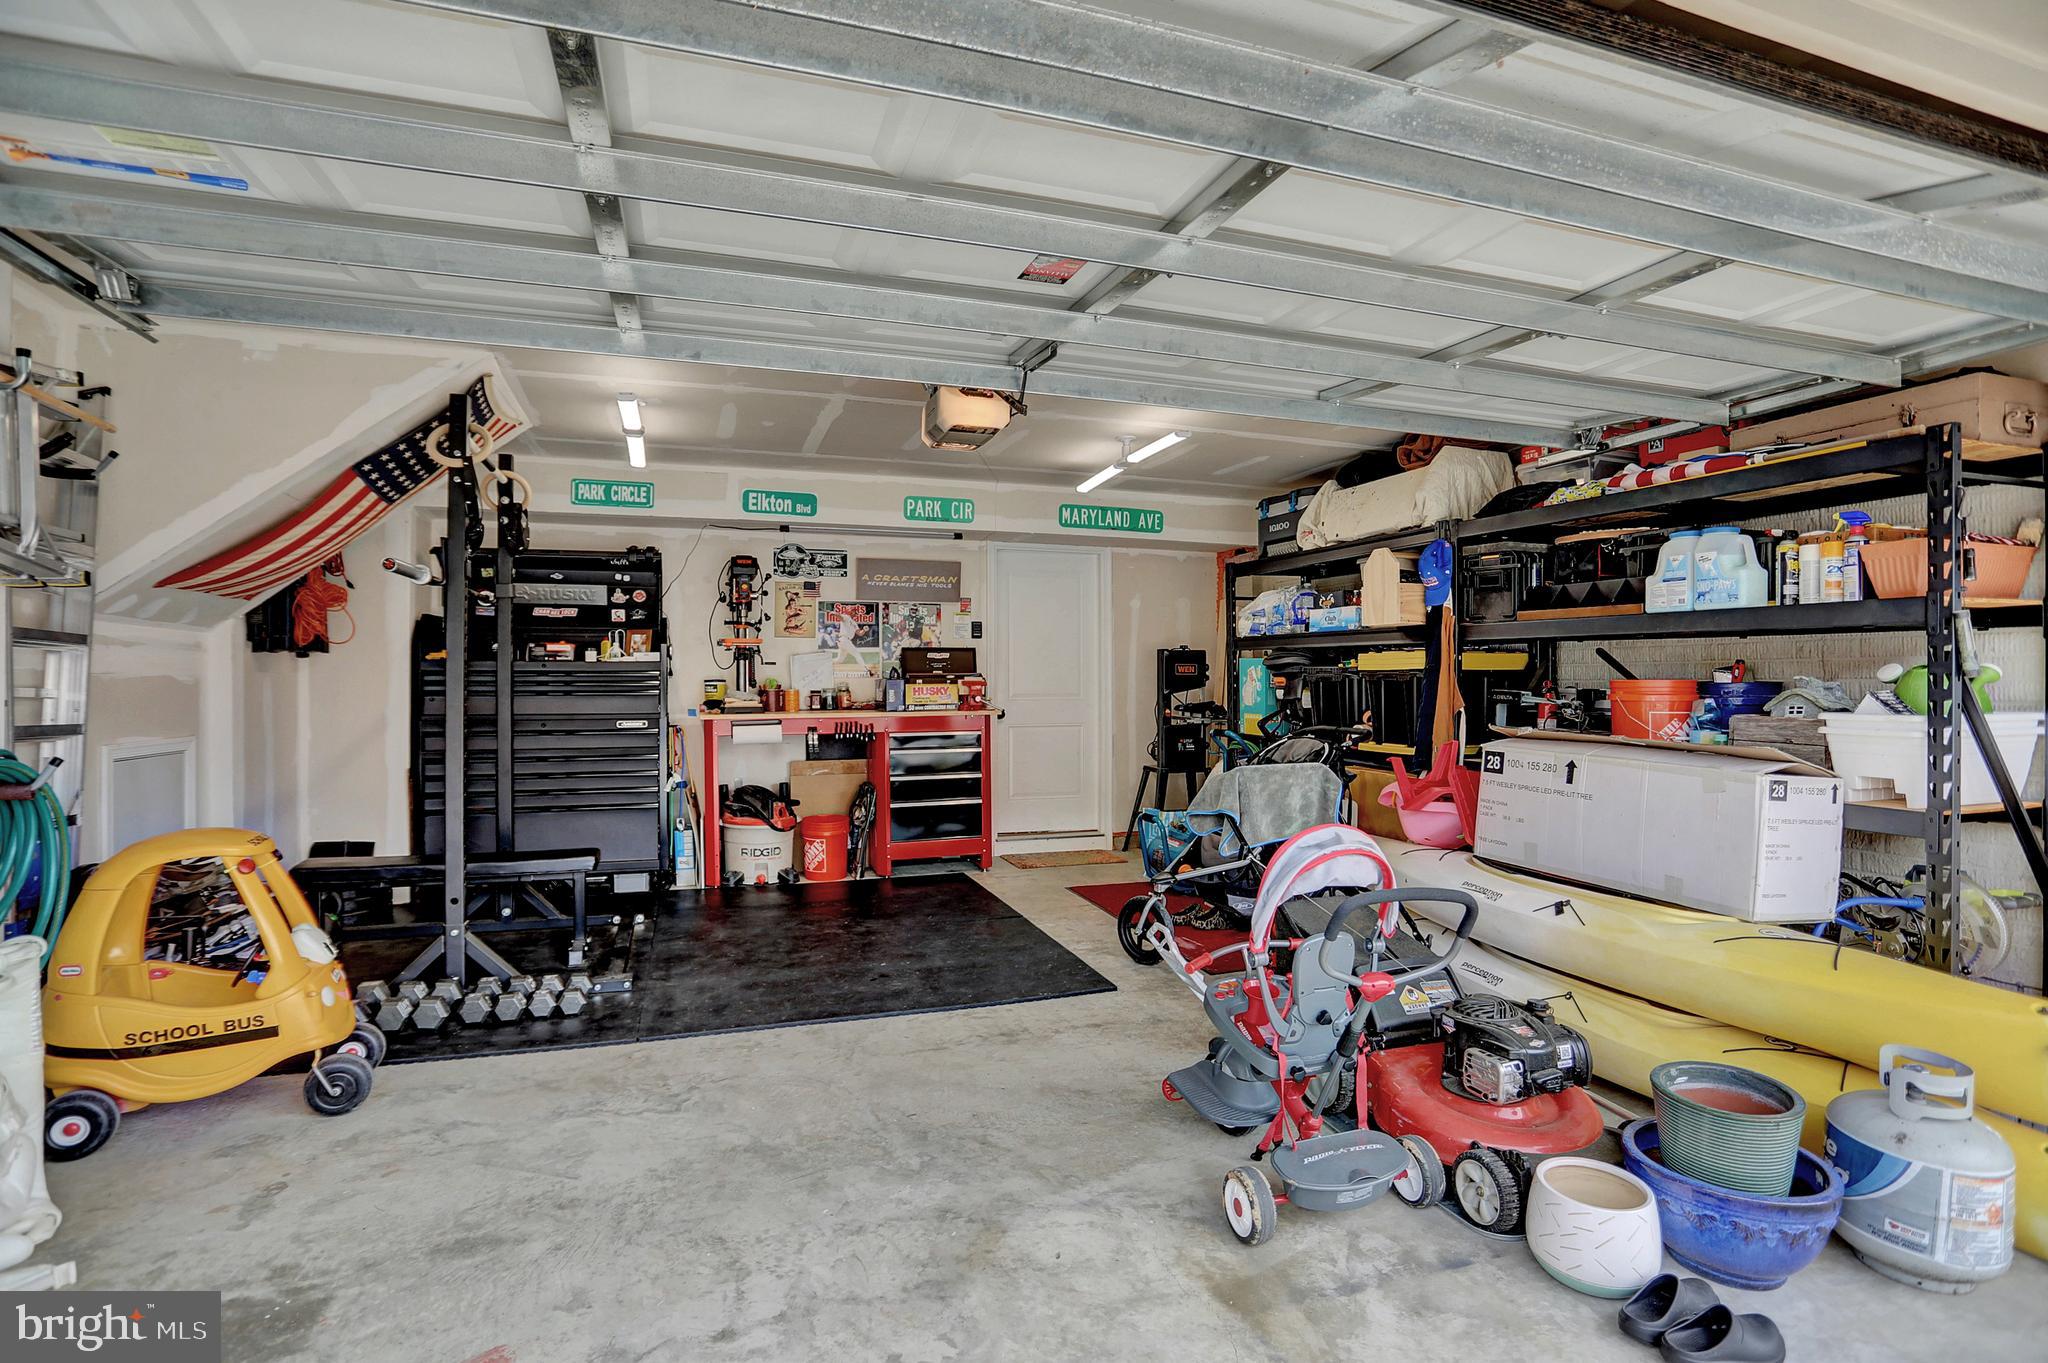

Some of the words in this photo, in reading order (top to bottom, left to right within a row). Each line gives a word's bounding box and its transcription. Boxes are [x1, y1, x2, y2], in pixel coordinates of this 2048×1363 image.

[578, 483, 605, 500] PARK
[611, 485, 647, 502] CIRCLE
[749, 492, 792, 513] Elkton
[796, 503, 811, 514] Blvd
[907, 499, 941, 518] PARK
[951, 501, 973, 520] CIR
[1062, 507, 1130, 528] MARYLAND
[1138, 512, 1161, 530] AVE
[1269, 521, 1290, 533] IGLOO
[1827, 564, 1844, 574] 2X
[874, 574, 958, 583] CRAFTSMAN
[537, 588, 597, 600] HUSKY
[913, 687, 949, 696] HUSKY
[1487, 755, 1500, 769] 28
[1527, 762, 1540, 771] 155
[1543, 763, 1557, 773] 280
[1497, 781, 1517, 789] WESLEY
[1518, 784, 1540, 793] SPRUCE
[1553, 789, 1575, 798] PRE-LIT
[1576, 792, 1592, 800] TREE
[1772, 784, 1785, 798] 28
[1790, 787, 1804, 795] 1004
[1816, 788, 1826, 796] 280
[741, 847, 782, 857] RIDGID
[808, 853, 825, 872] DEPOT
[1462, 880, 1503, 898] perception
[1461, 961, 1504, 983] perception
[123, 1023, 214, 1046] SCHOOL
[223, 1014, 266, 1032] BUS
